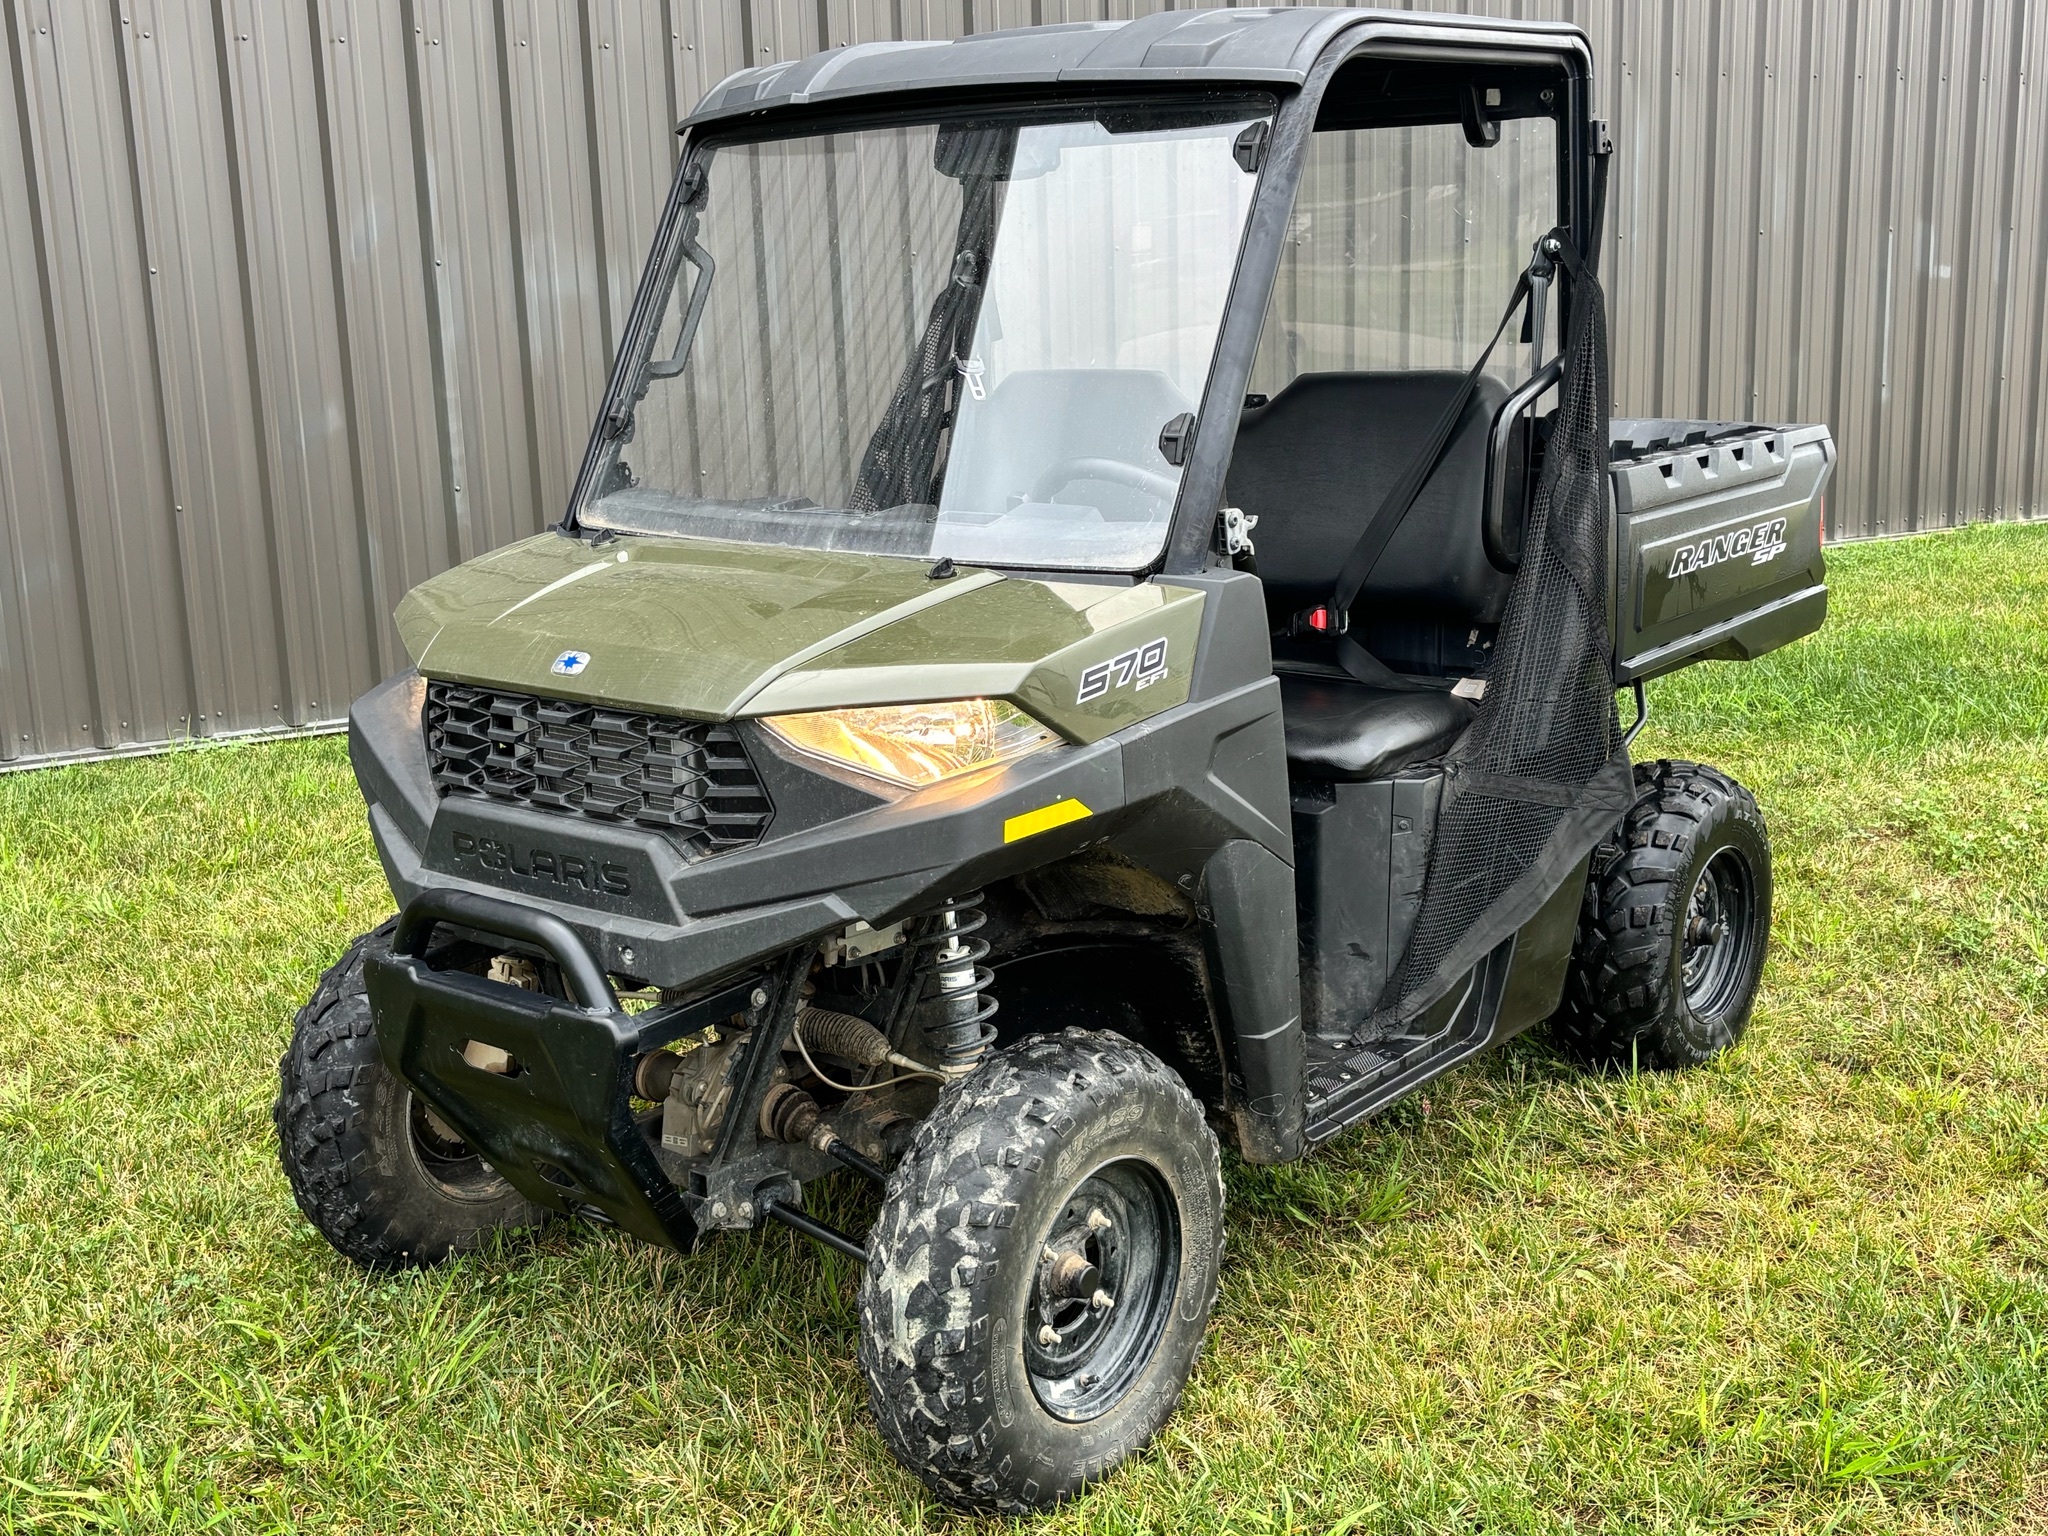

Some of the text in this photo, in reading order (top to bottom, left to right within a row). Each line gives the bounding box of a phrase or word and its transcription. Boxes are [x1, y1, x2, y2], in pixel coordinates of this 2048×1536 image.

[1668, 517, 1787, 579] RANGER
[1751, 542, 1787, 566] SP
[1076, 636, 1168, 705] 570
[1135, 667, 1168, 692] EFI
[452, 831, 632, 897] POLARIS
